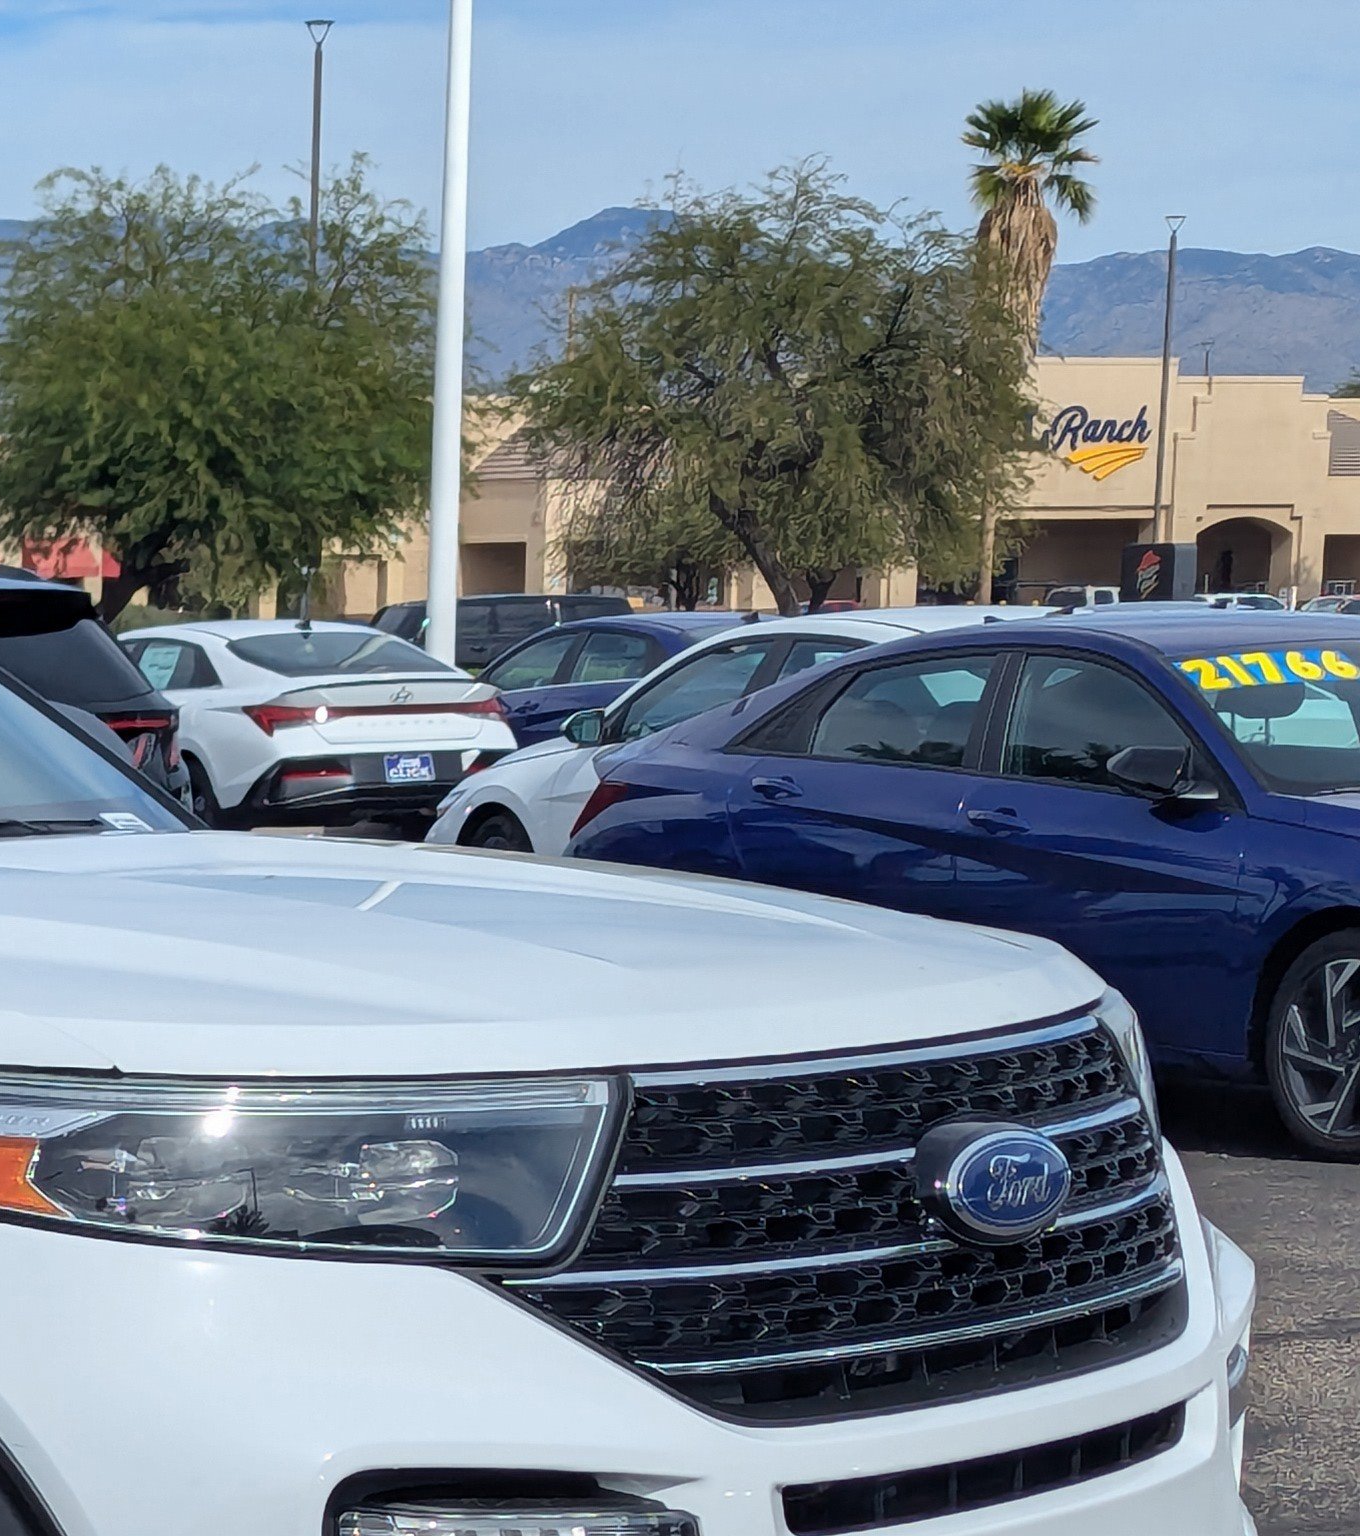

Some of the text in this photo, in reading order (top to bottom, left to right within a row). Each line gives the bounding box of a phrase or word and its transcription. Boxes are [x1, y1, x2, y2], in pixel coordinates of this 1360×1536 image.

[1050, 404, 1152, 451] Ranch
[1180, 650, 1359, 691] 21766
[986, 1152, 1051, 1212] Ford
